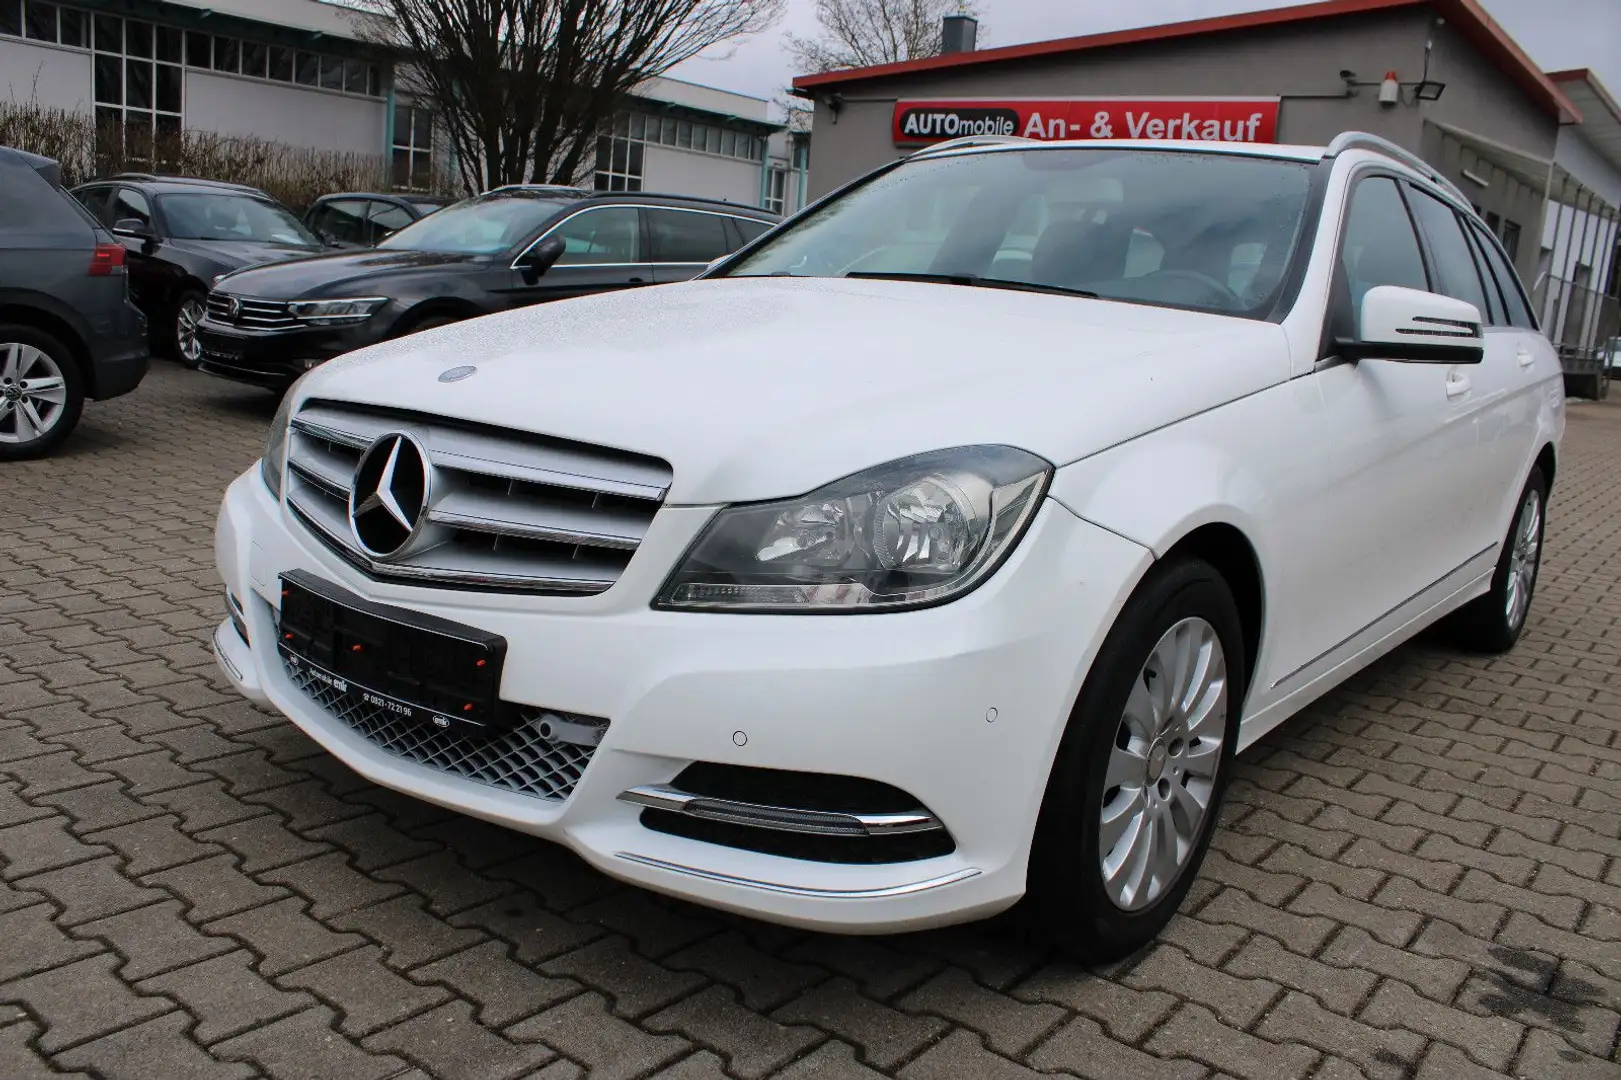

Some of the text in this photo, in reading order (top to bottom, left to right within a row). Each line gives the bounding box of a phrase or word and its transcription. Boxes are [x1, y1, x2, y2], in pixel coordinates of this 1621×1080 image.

[904, 111, 1263, 141] AUTOmobile An- & Verkauf
[403, 707, 412, 717] 96
